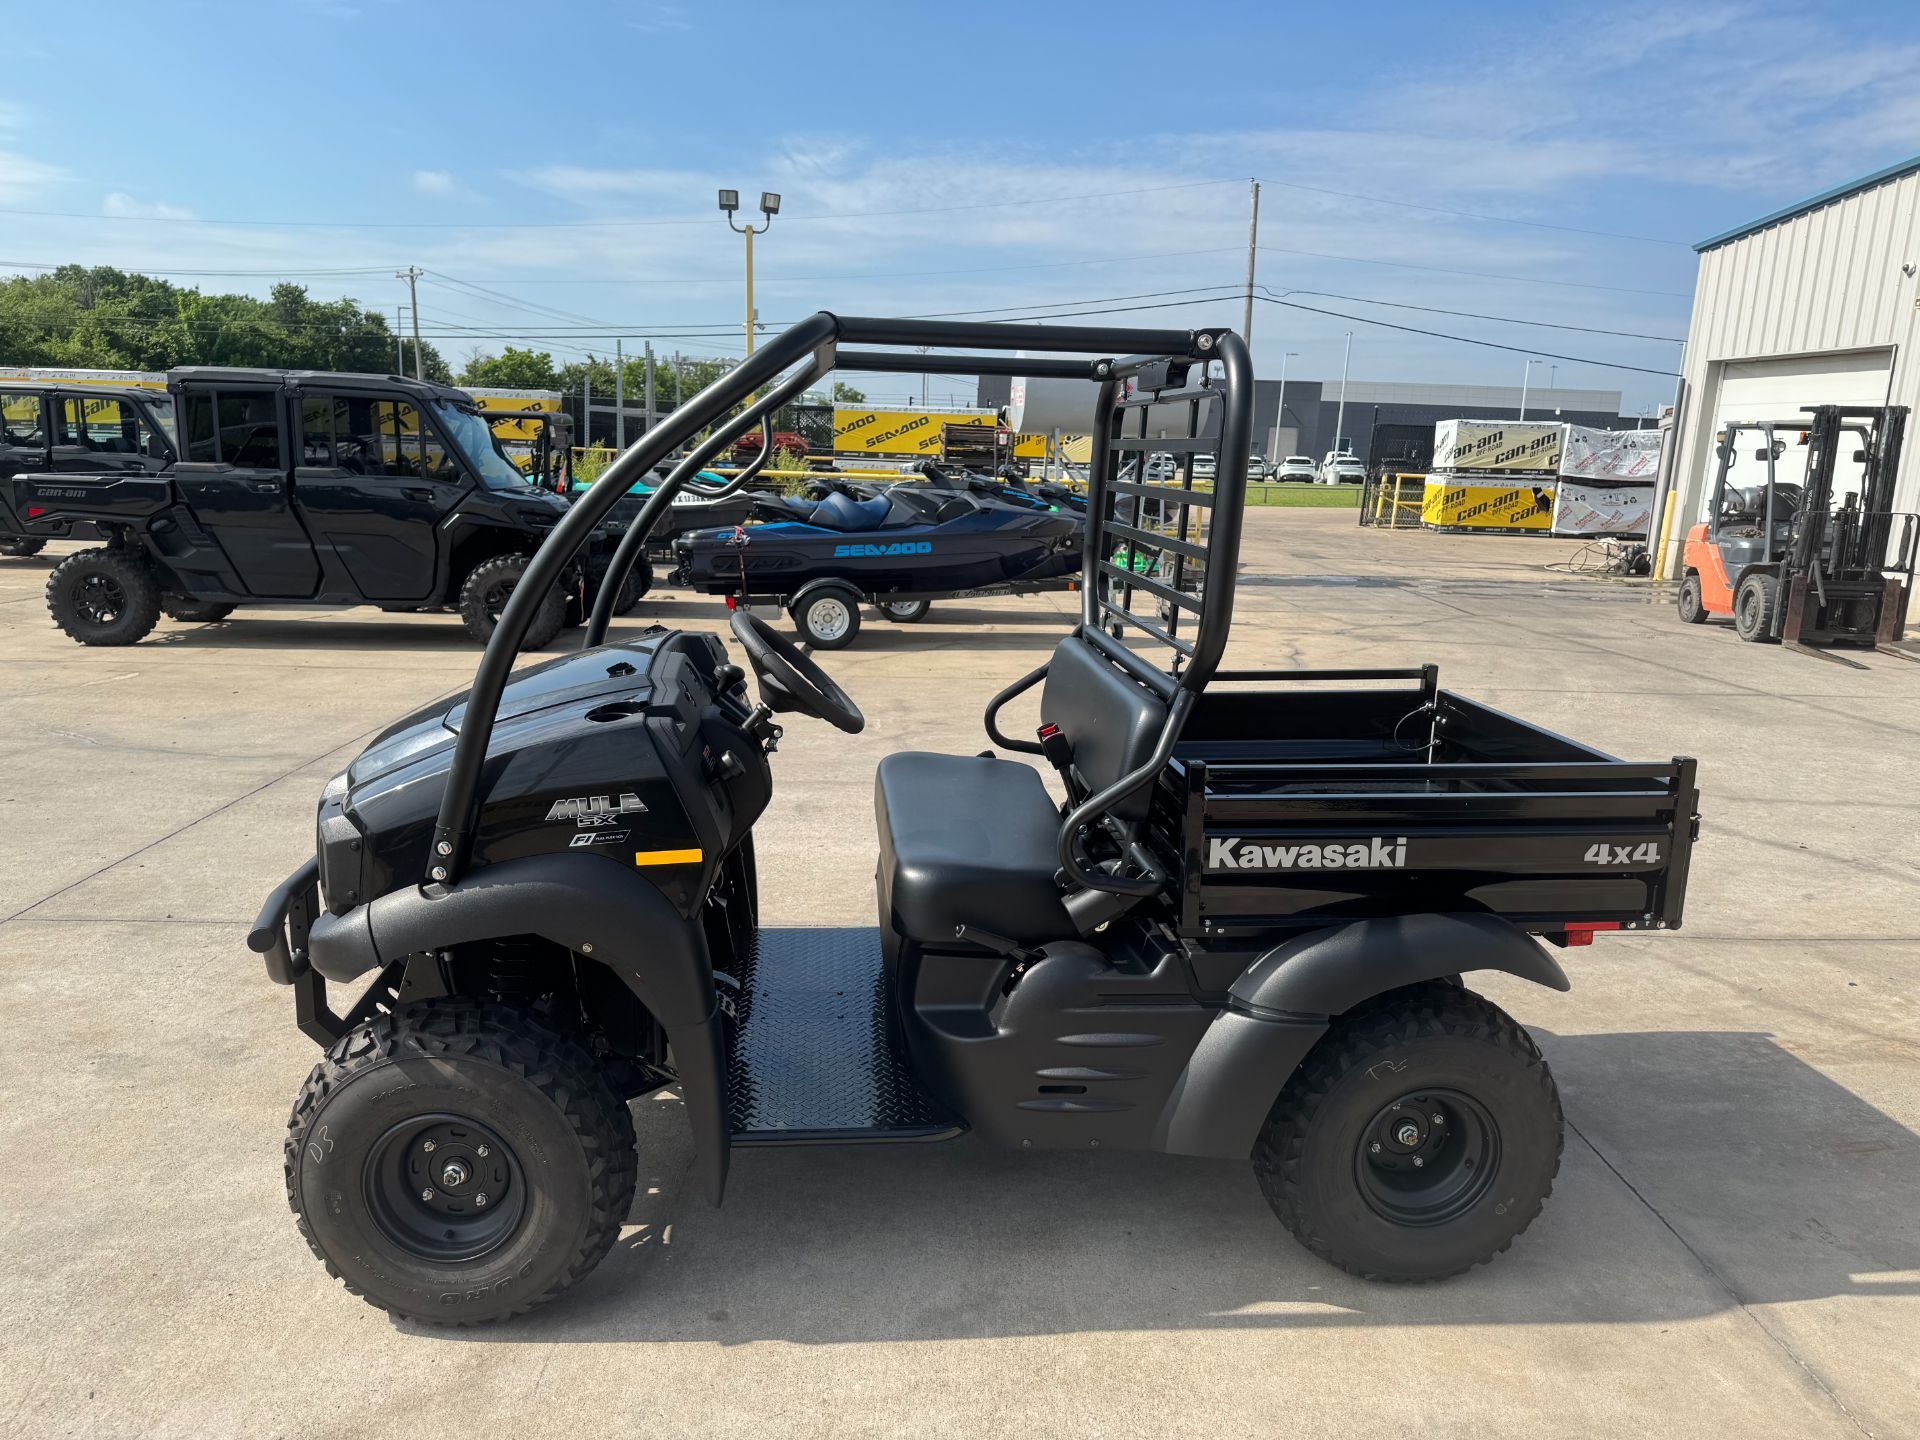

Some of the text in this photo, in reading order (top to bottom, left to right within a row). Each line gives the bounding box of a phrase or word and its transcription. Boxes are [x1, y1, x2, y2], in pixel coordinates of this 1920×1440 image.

[1494, 432, 1557, 465] can-am
[37, 488, 87, 498] can-am
[1457, 490, 1519, 522] can-am
[545, 793, 649, 820] MULE
[577, 814, 618, 828] SX
[1208, 837, 1661, 868] Kawasaki 4x4
